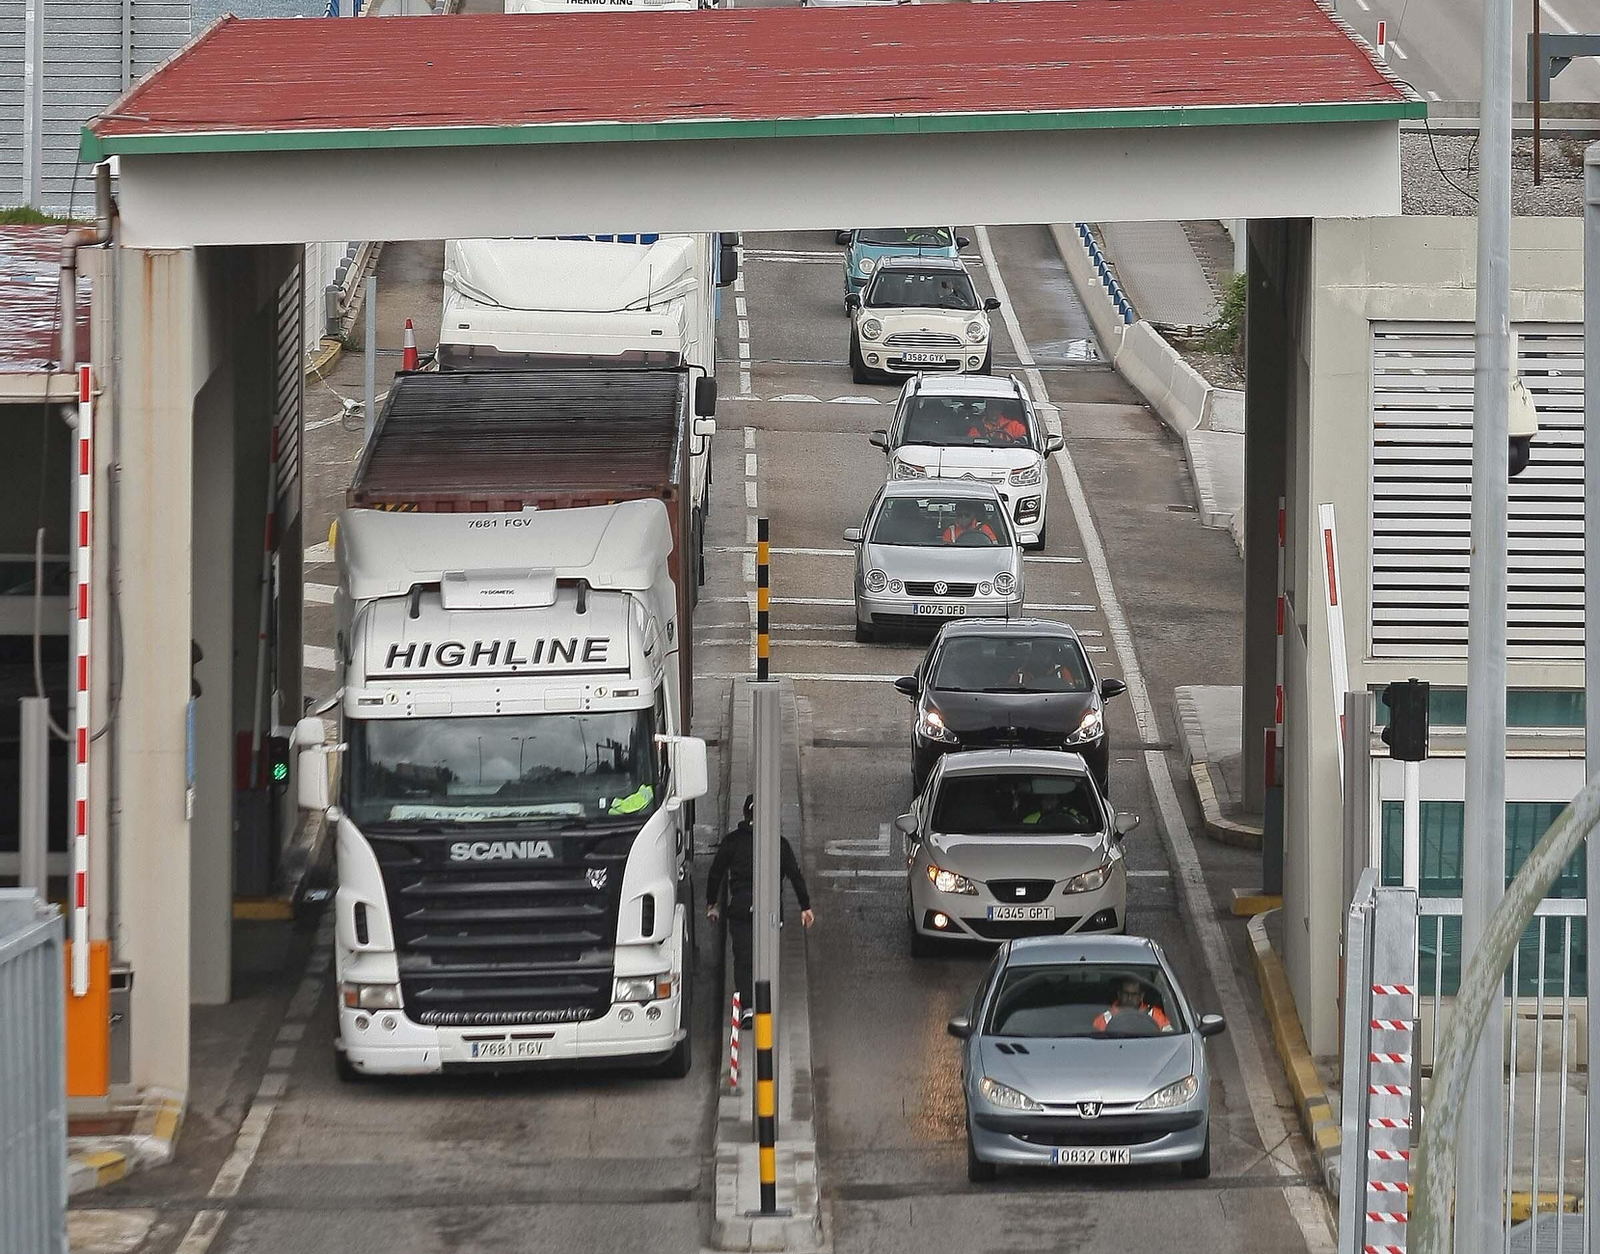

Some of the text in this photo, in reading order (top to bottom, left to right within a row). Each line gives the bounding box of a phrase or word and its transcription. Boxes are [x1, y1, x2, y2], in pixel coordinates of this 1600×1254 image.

[907, 353, 945, 362] 3582 GYK
[467, 518, 533, 529] 7681 FGV
[919, 605, 966, 615] 0075 DFB
[384, 636, 611, 670] HIGHLINE
[449, 840, 555, 862] SCANIA
[996, 907, 1050, 919] 4345 GPT
[480, 1042, 544, 1056] 7681 FGV
[1061, 1148, 1126, 1163] 0832 CWK
